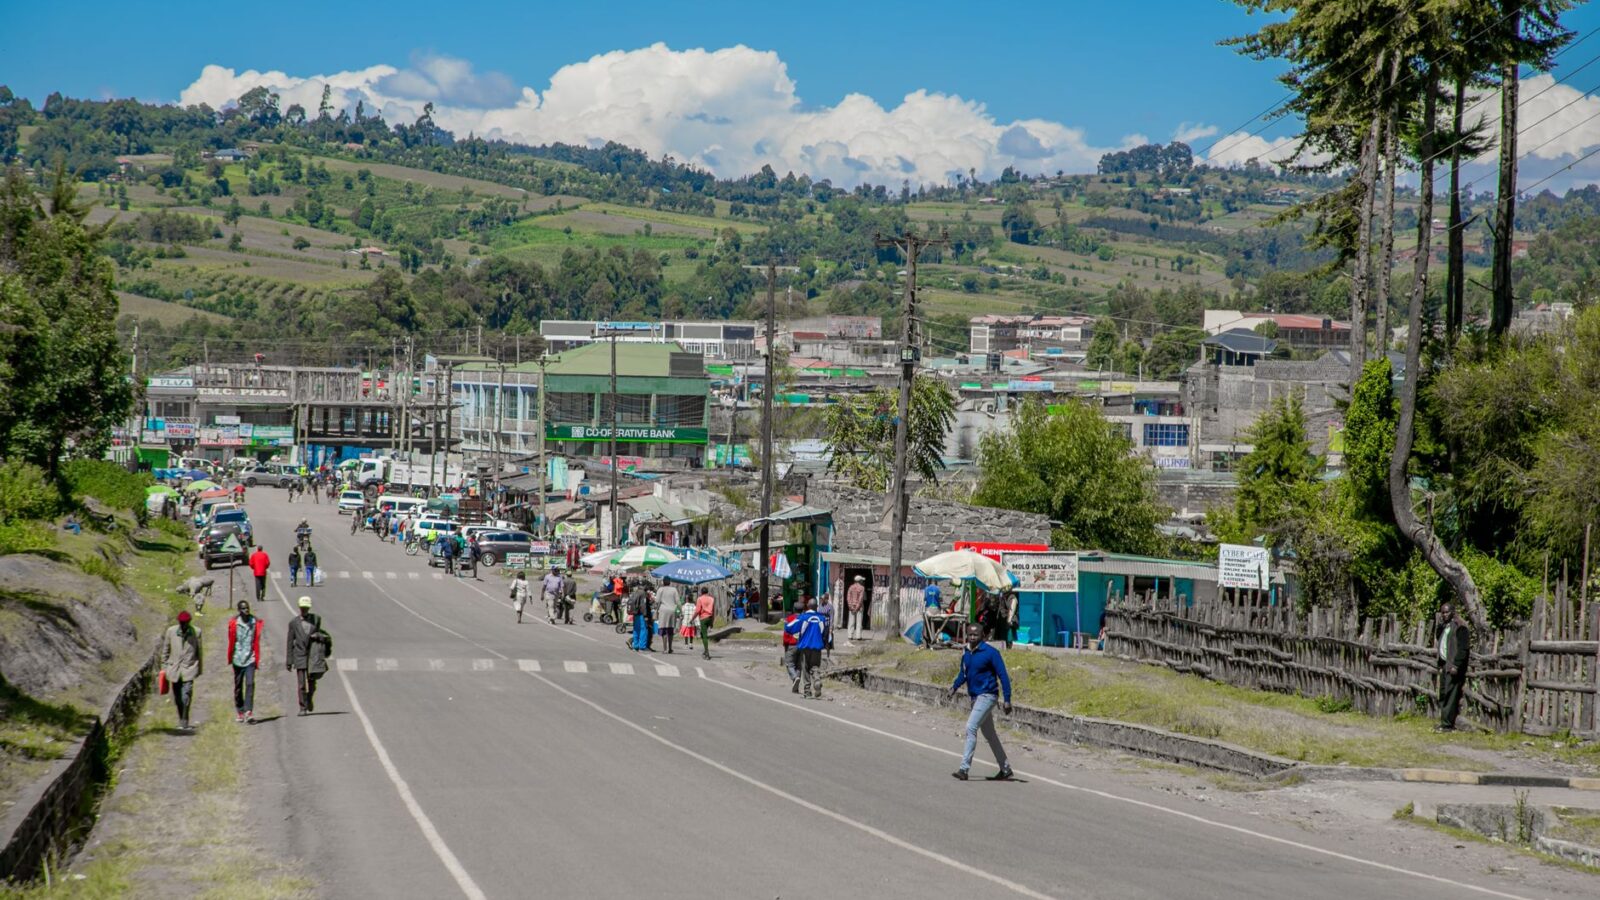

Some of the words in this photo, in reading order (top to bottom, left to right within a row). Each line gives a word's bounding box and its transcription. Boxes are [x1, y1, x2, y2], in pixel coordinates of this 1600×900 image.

[240, 388, 288, 397] PLAZA
[650, 428, 676, 438] BANK
[1222, 550, 1245, 558] CYBER
